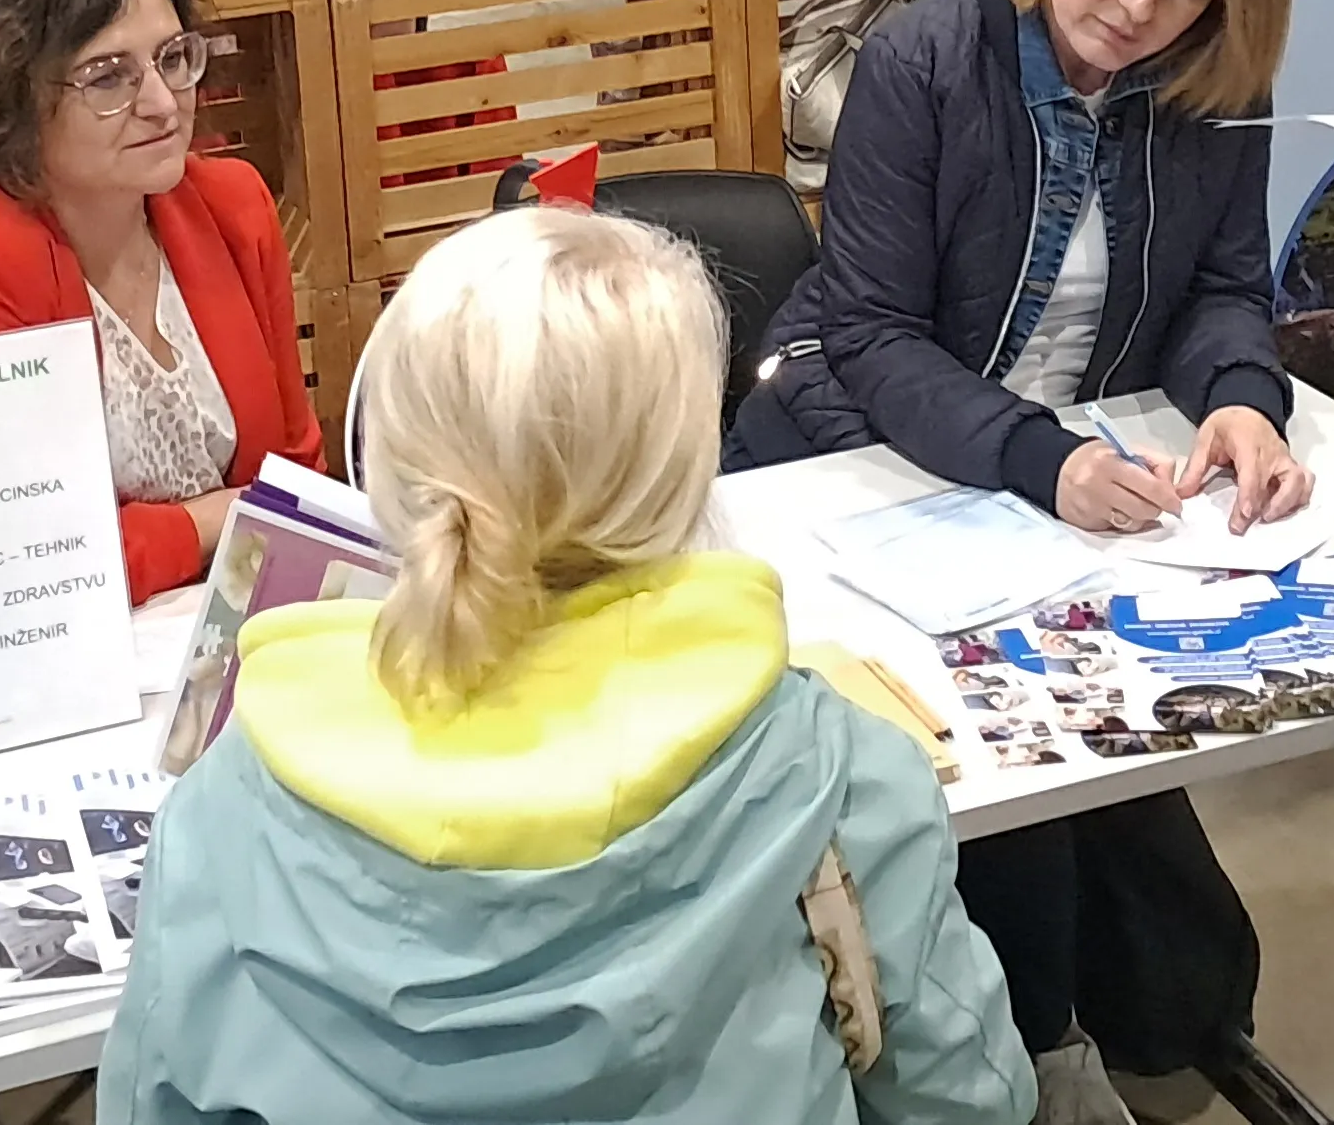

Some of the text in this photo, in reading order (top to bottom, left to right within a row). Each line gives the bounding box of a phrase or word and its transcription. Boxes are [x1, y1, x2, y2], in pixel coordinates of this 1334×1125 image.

[23, 535, 88, 561] TEHNIK
[3, 572, 107, 607] ZDRAVSTVU
[0, 622, 69, 650] INŽENIR
